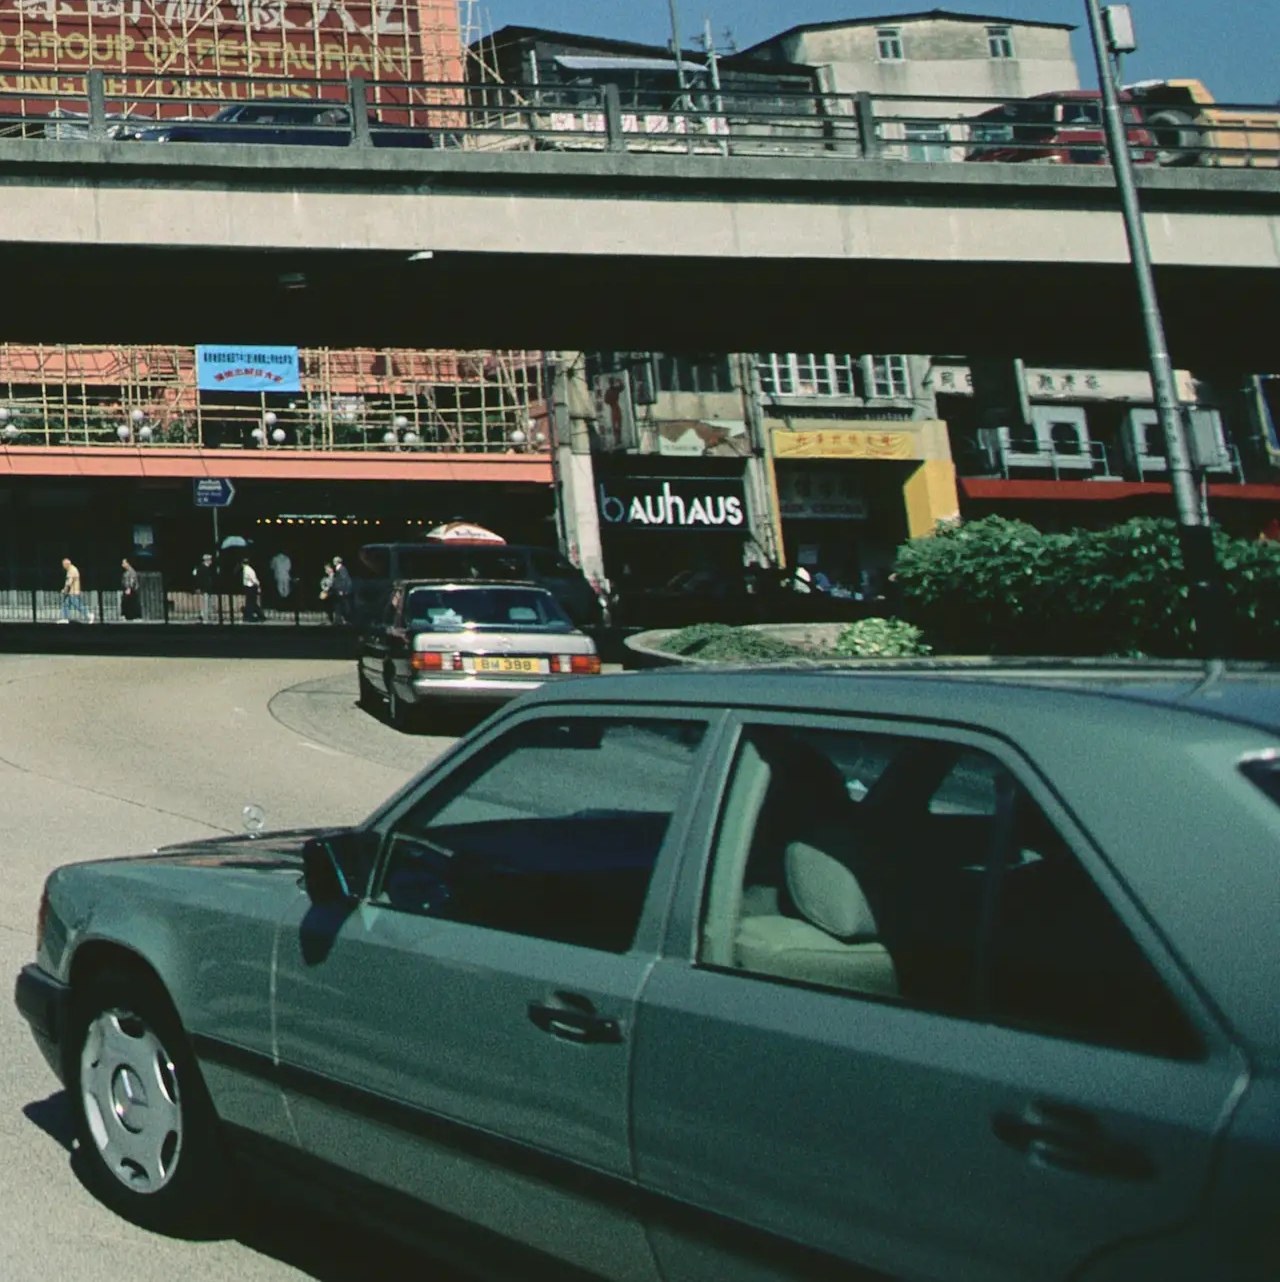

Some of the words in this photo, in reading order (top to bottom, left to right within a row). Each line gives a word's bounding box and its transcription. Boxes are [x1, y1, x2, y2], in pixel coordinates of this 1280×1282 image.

[16, 29, 136, 63] GROUP
[143, 34, 187, 65] OF
[195, 36, 414, 73] RESTAURANT
